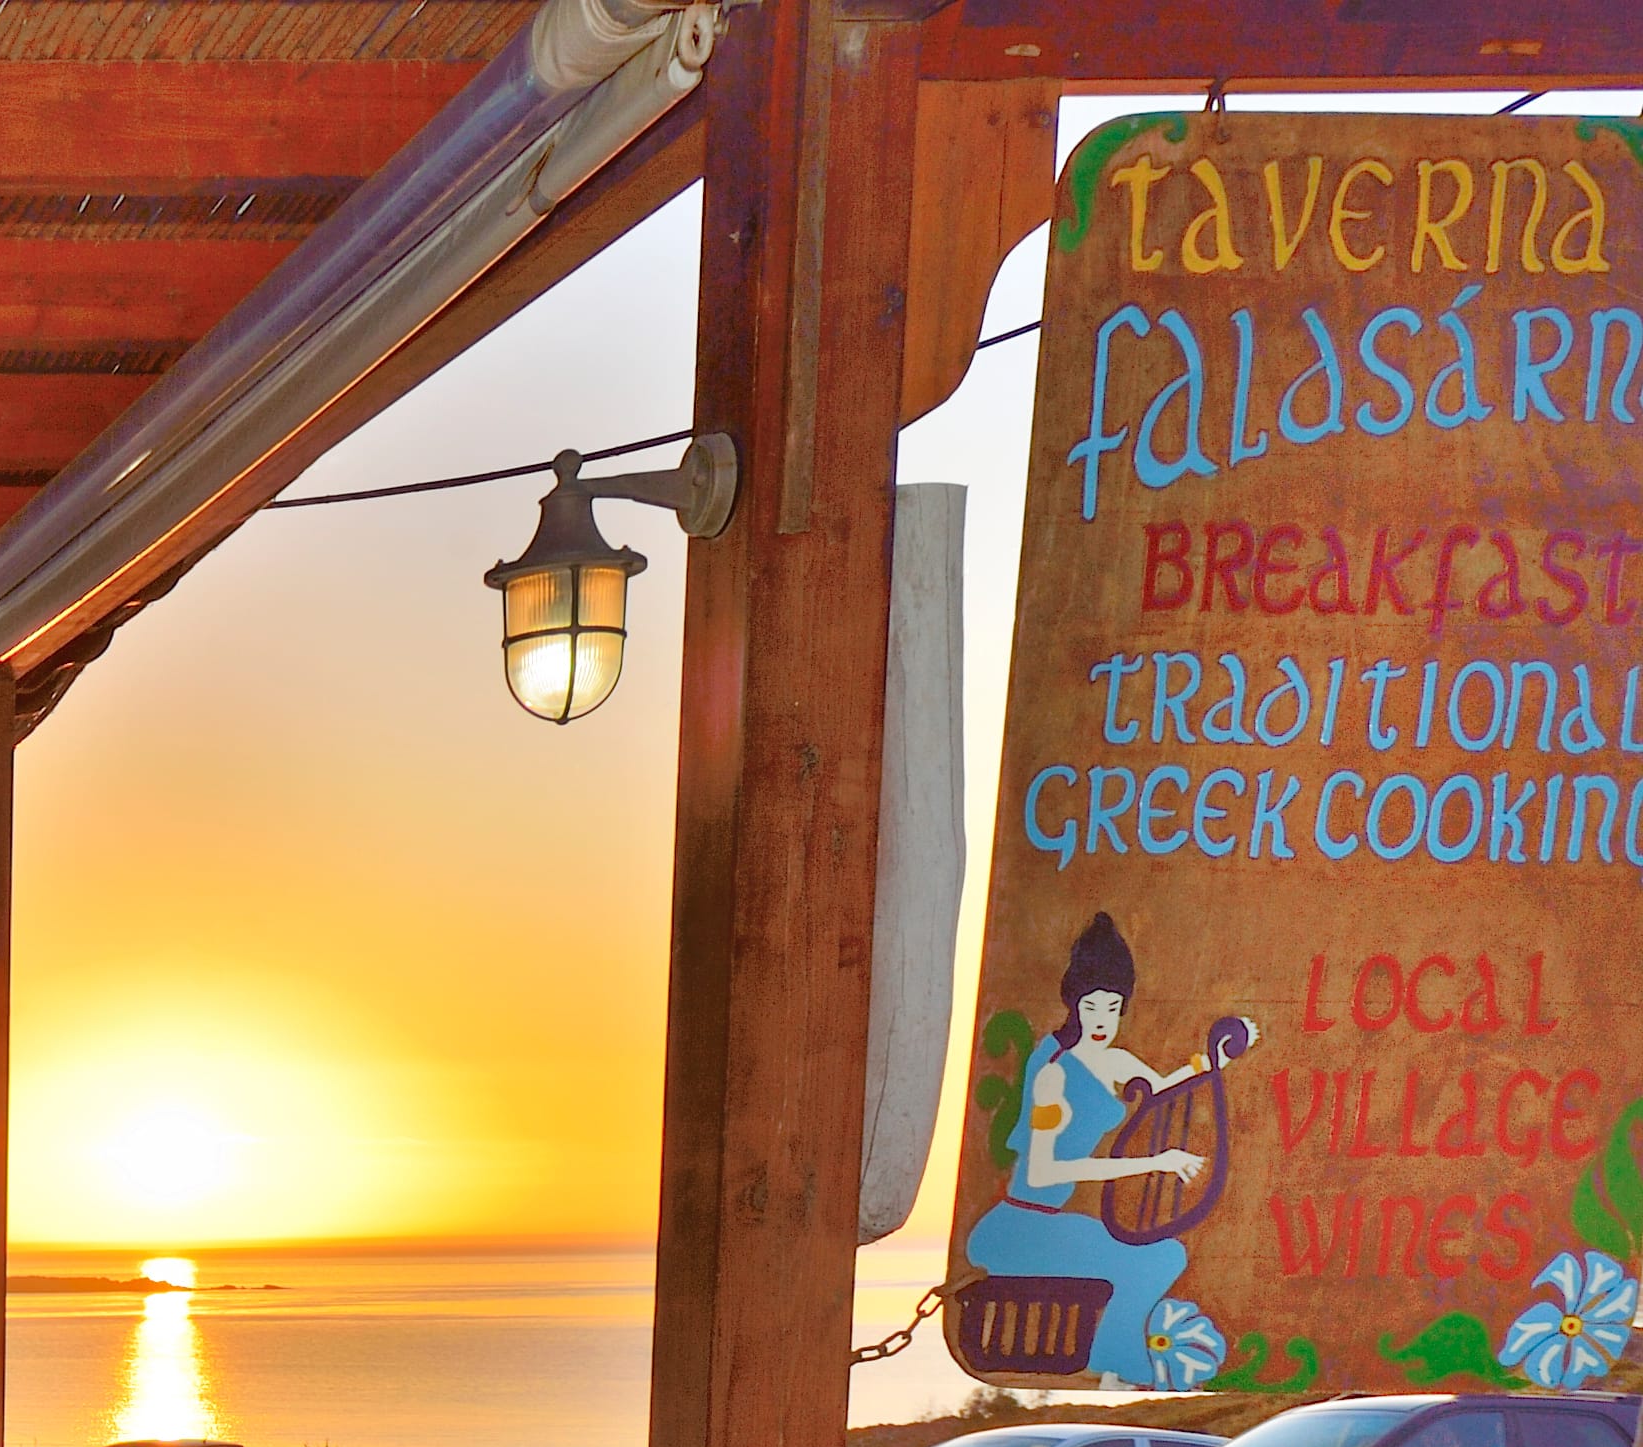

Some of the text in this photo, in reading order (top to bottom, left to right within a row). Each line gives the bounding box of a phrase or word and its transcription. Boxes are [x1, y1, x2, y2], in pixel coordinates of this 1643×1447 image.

[1112, 154, 1612, 276] TAVERNA
[1066, 285, 1643, 521] FALASÁRN
[1140, 521, 1643, 636] BREAKFAST
[1088, 650, 1643, 753] TRADITIONAL
[1024, 763, 1302, 872] GREEK
[1302, 951, 1561, 1035] LOCAL
[1271, 1069, 1602, 1168] VILLAGE
[1271, 1192, 1538, 1281] WINES
